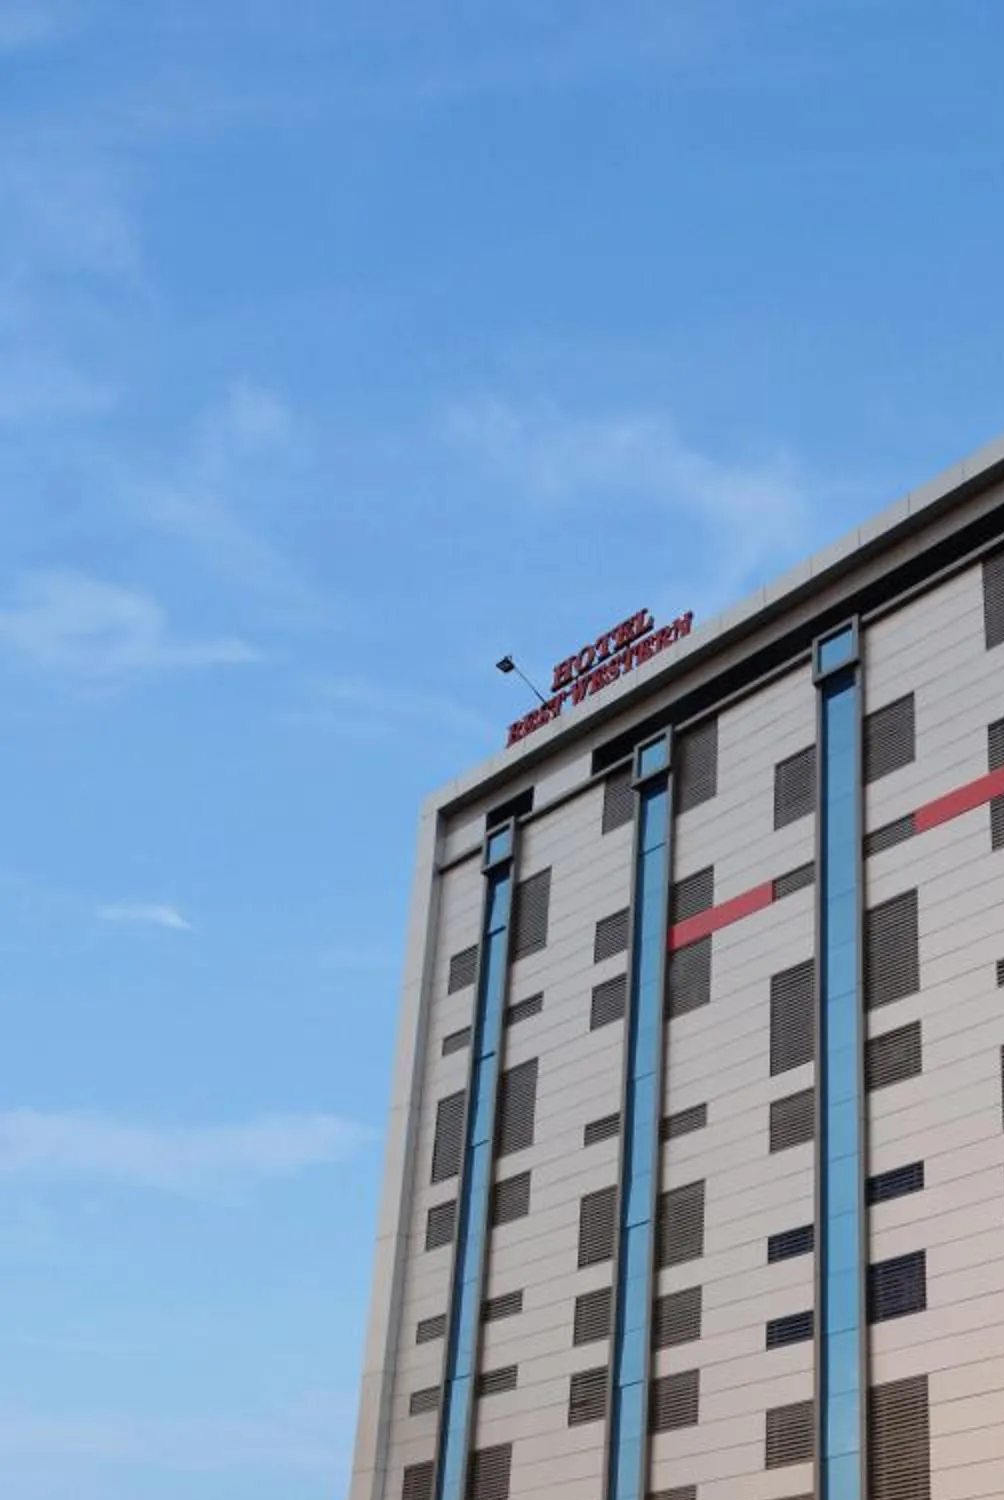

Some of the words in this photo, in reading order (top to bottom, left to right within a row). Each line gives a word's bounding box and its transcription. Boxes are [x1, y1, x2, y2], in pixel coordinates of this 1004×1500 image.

[507, 691, 566, 748] BEST
[569, 611, 693, 705] WESTERN
[552, 608, 655, 691] HOTEL
